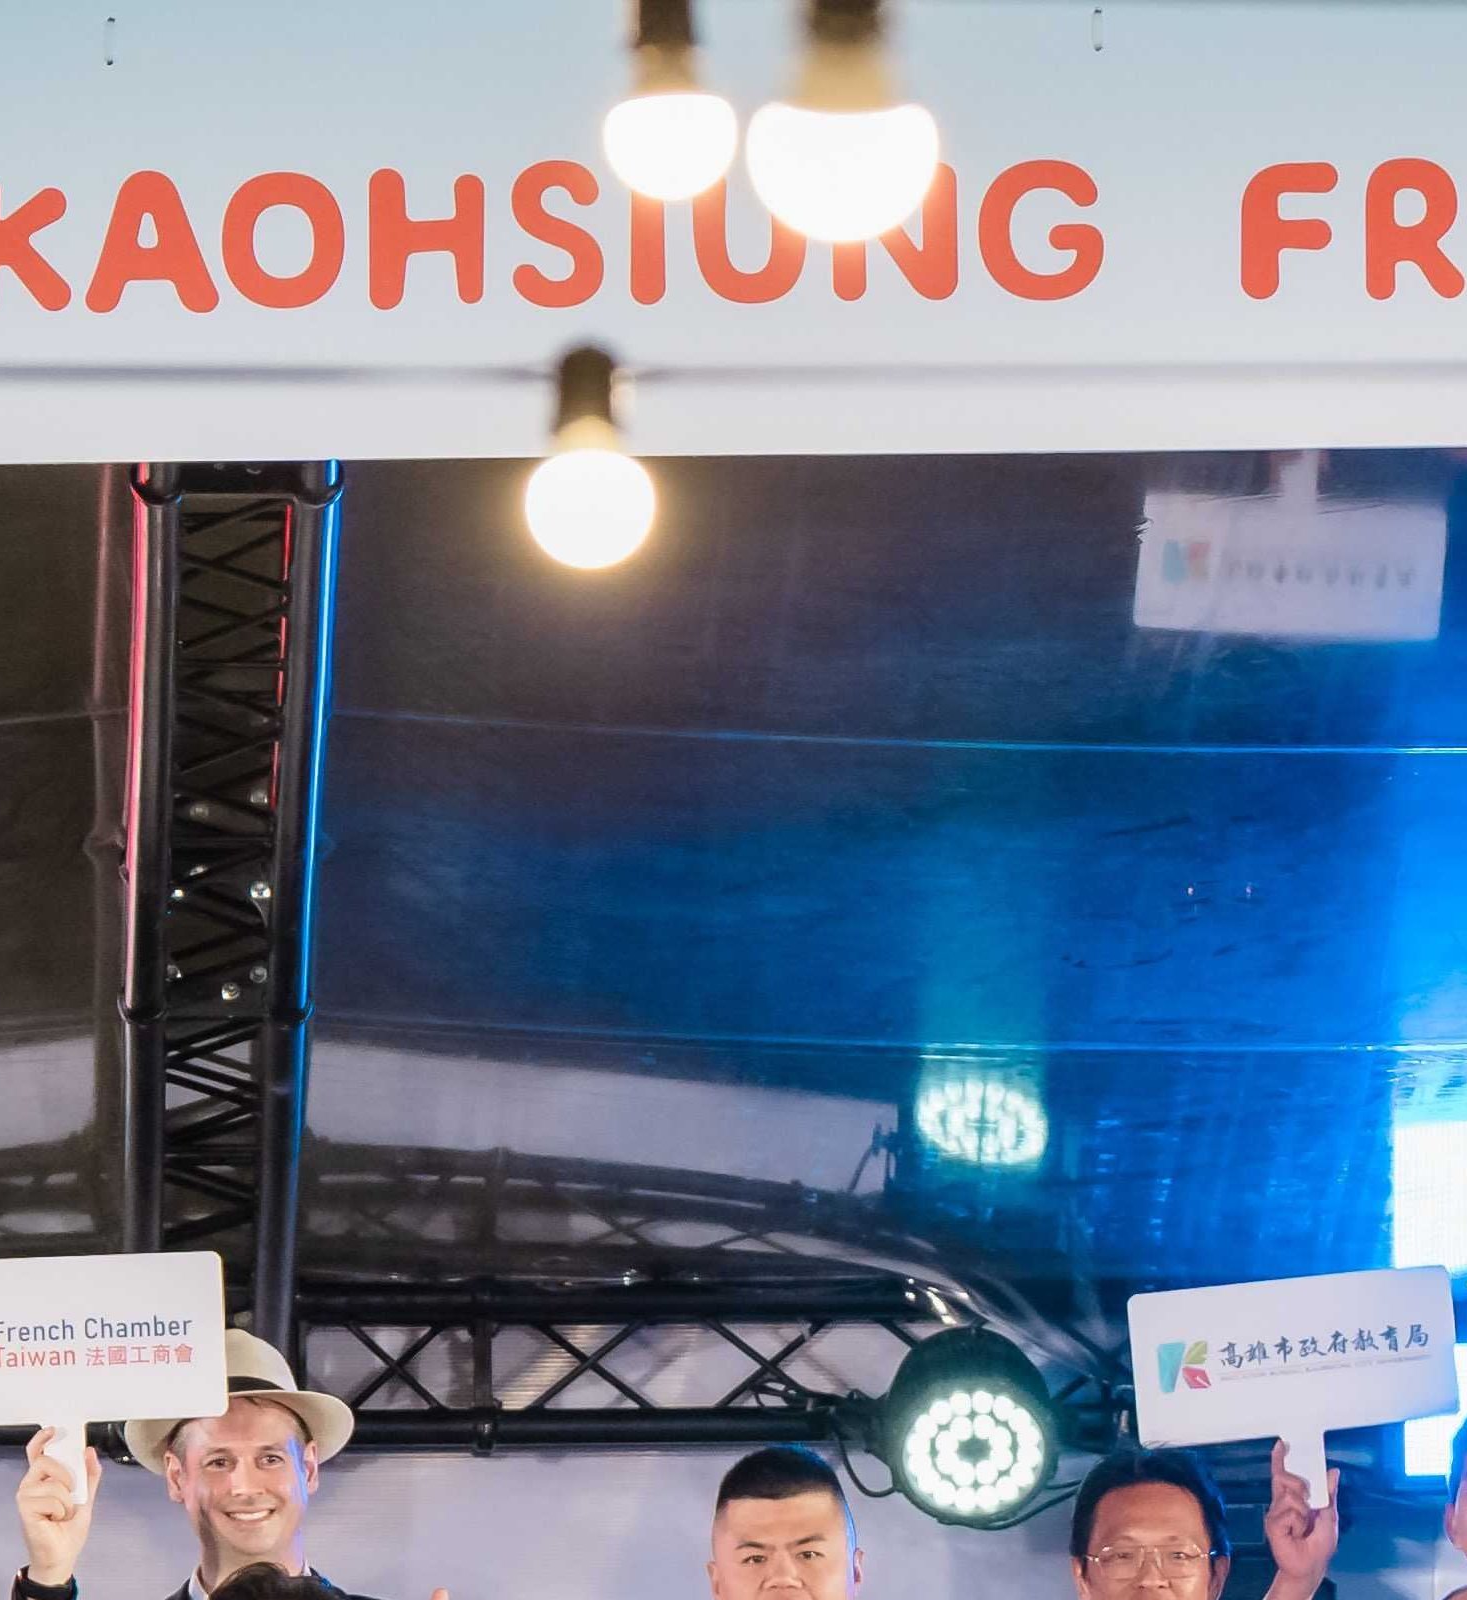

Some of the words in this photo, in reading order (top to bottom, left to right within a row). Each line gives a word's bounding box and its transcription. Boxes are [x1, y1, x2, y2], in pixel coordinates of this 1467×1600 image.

[83, 1315, 193, 1339] Chamber
[85, 1343, 194, 1368] 法國工商會
[1217, 1324, 1430, 1369] 高雄市政府教育局
